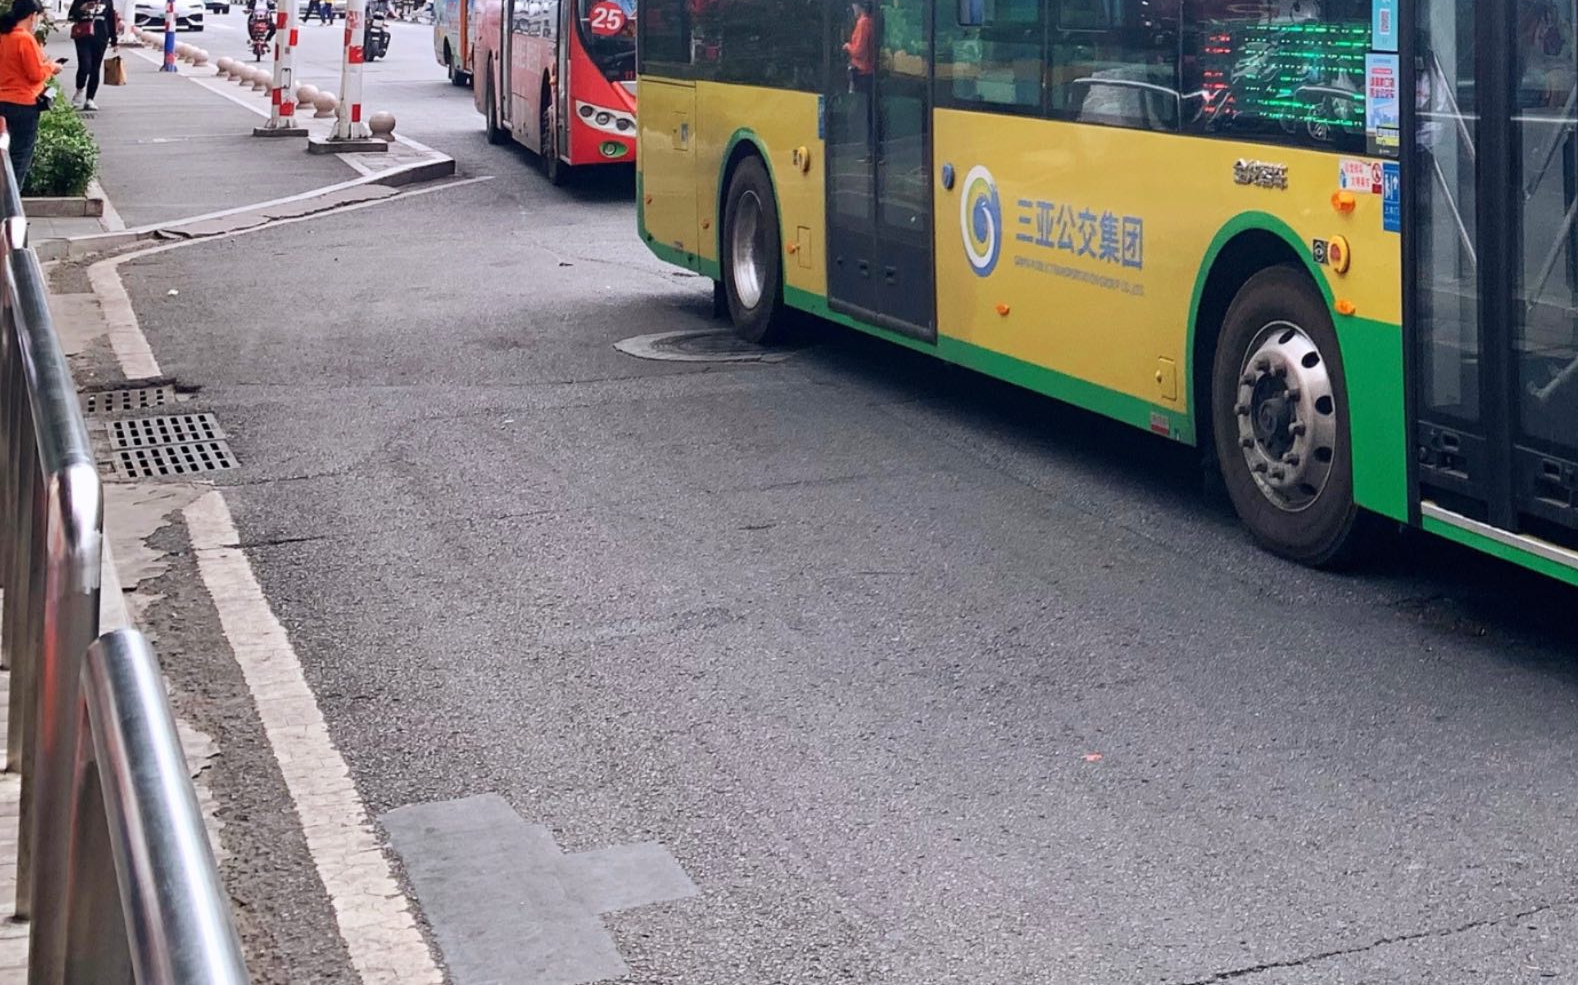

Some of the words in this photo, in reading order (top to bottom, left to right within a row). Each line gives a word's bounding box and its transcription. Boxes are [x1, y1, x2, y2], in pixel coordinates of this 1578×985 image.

[591, 7, 622, 31] 25
[1015, 198, 1144, 271] 三亚公交集团
